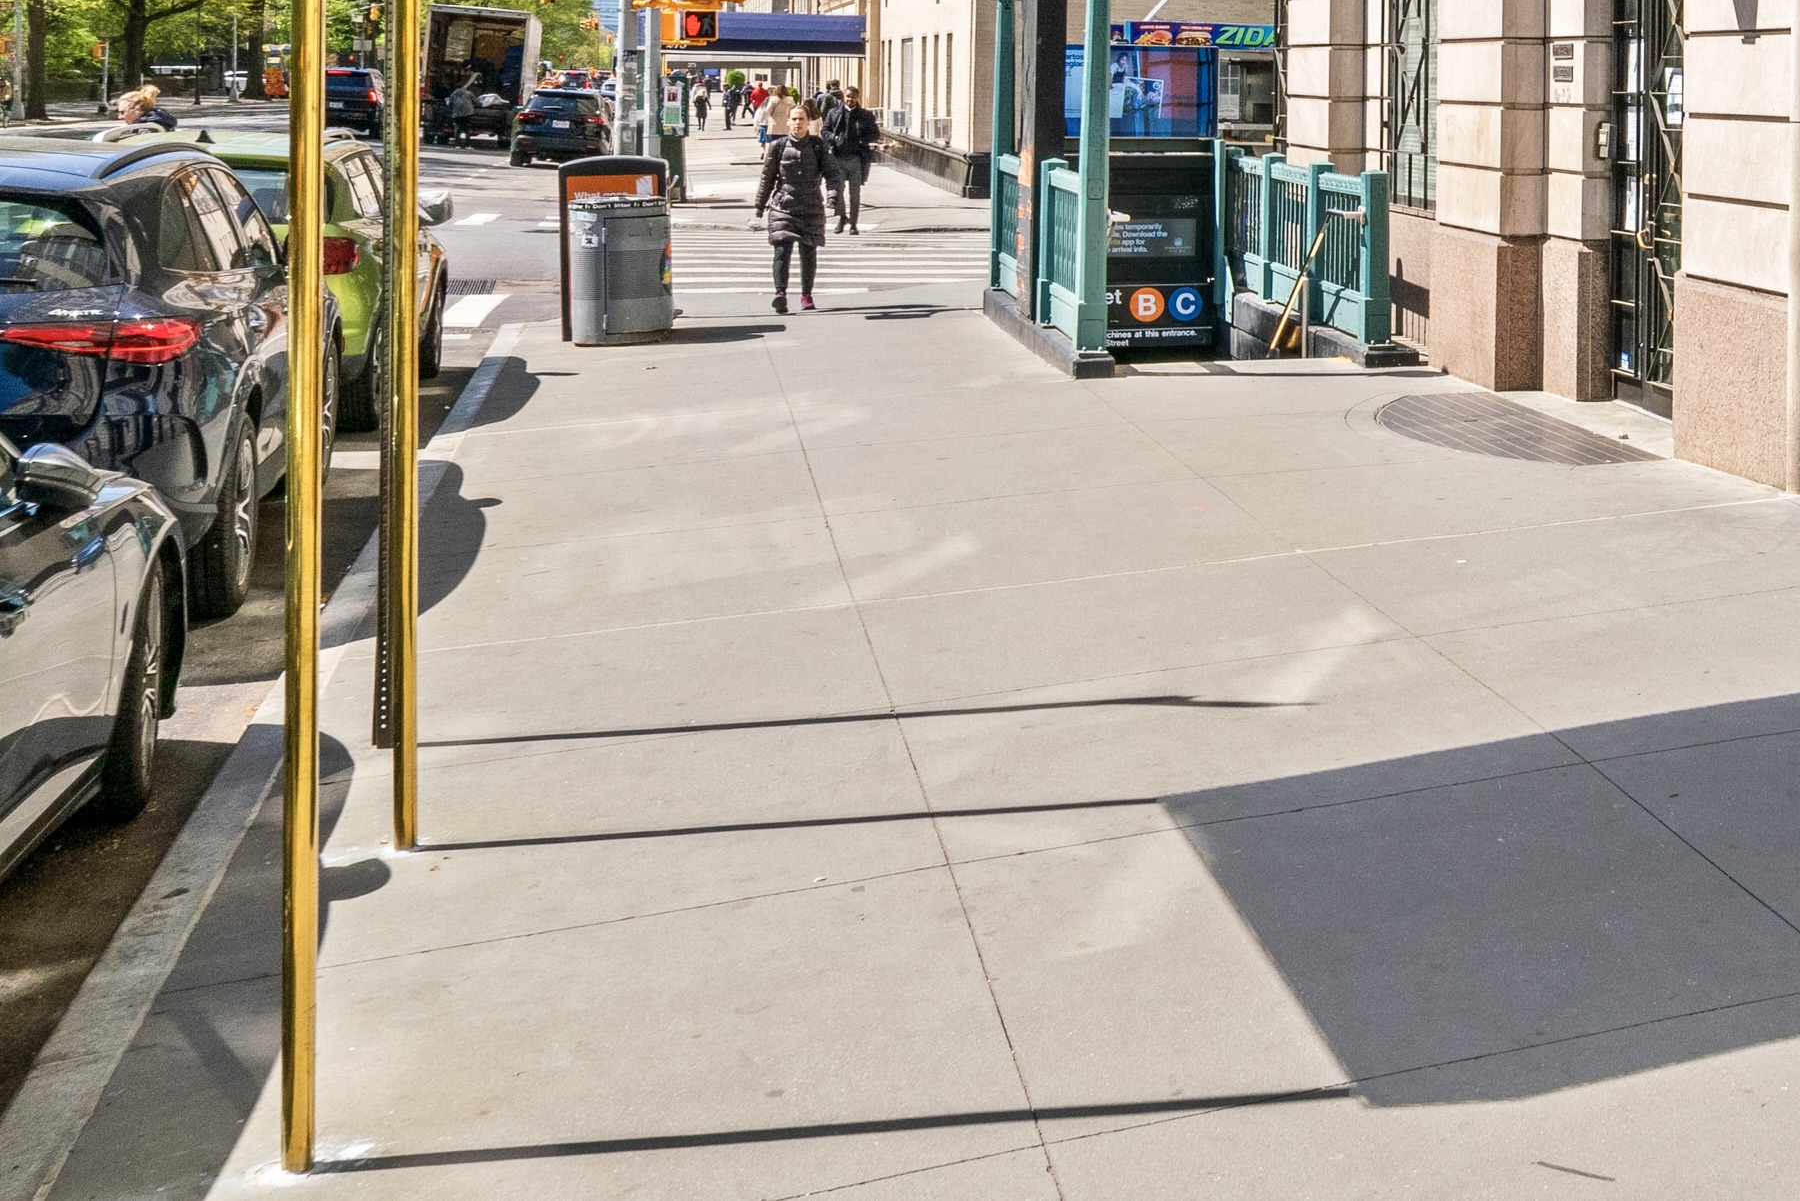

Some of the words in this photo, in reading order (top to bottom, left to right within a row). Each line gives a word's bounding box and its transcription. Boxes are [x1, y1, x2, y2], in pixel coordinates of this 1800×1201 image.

[1125, 223, 1162, 231] temporarily
[1138, 294, 1157, 316] B
[1176, 293, 1196, 315] C
[1134, 330, 1142, 338] at
[1145, 330, 1160, 338] this
[1162, 329, 1198, 337] entrance.
[1105, 339, 1130, 347] Street
